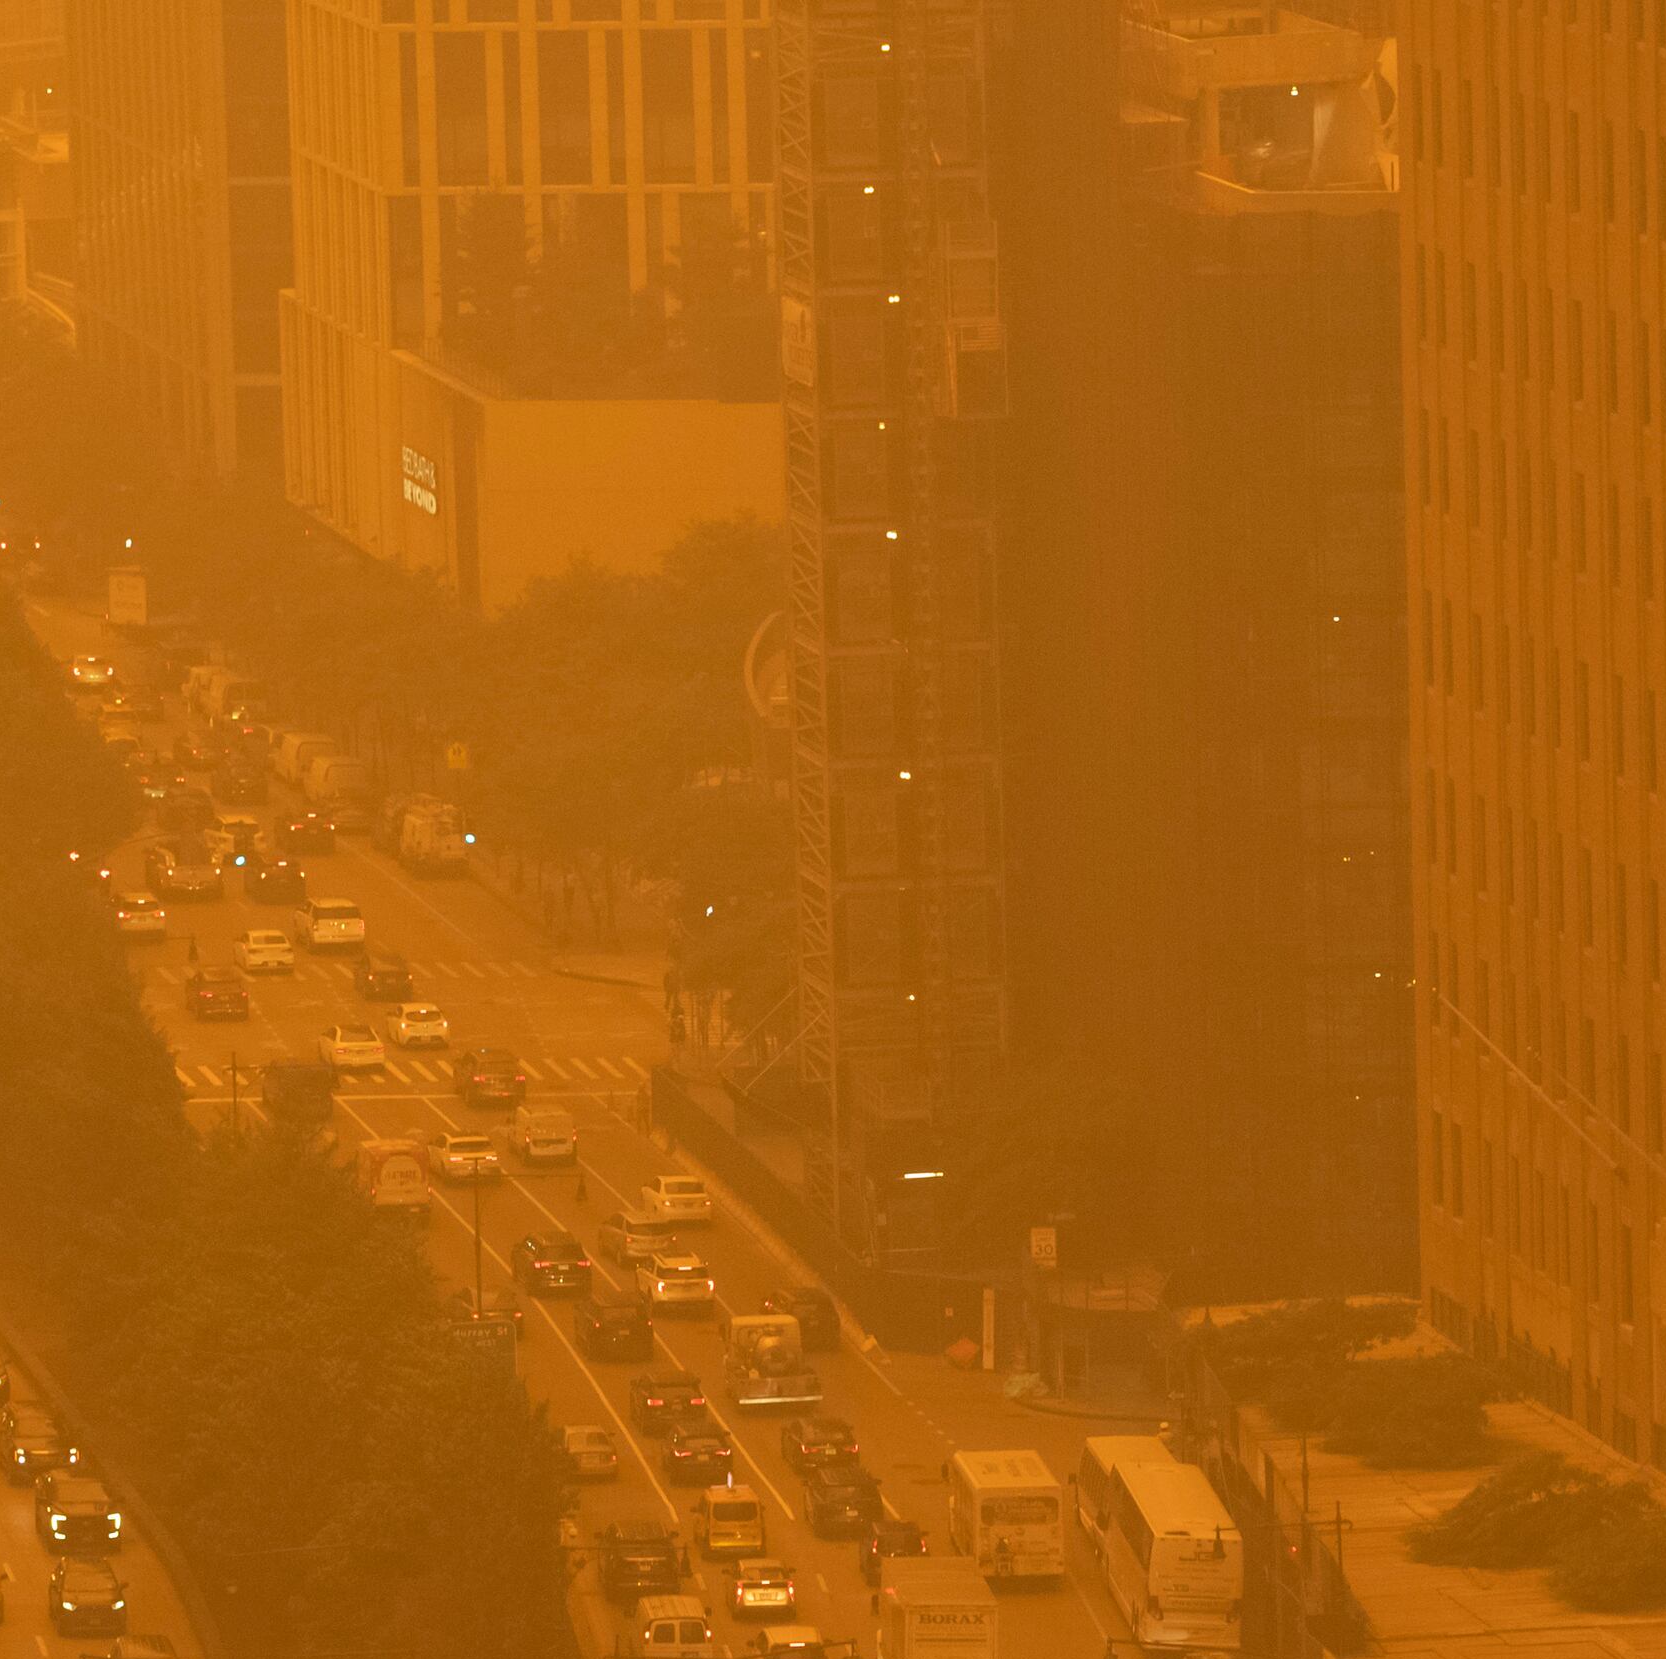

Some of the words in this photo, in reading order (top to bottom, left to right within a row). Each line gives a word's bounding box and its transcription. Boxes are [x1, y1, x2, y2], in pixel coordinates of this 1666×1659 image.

[403, 477, 437, 515] BEYOND
[1035, 1244, 1053, 1256] 30
[919, 1613, 985, 1625] BORAX
